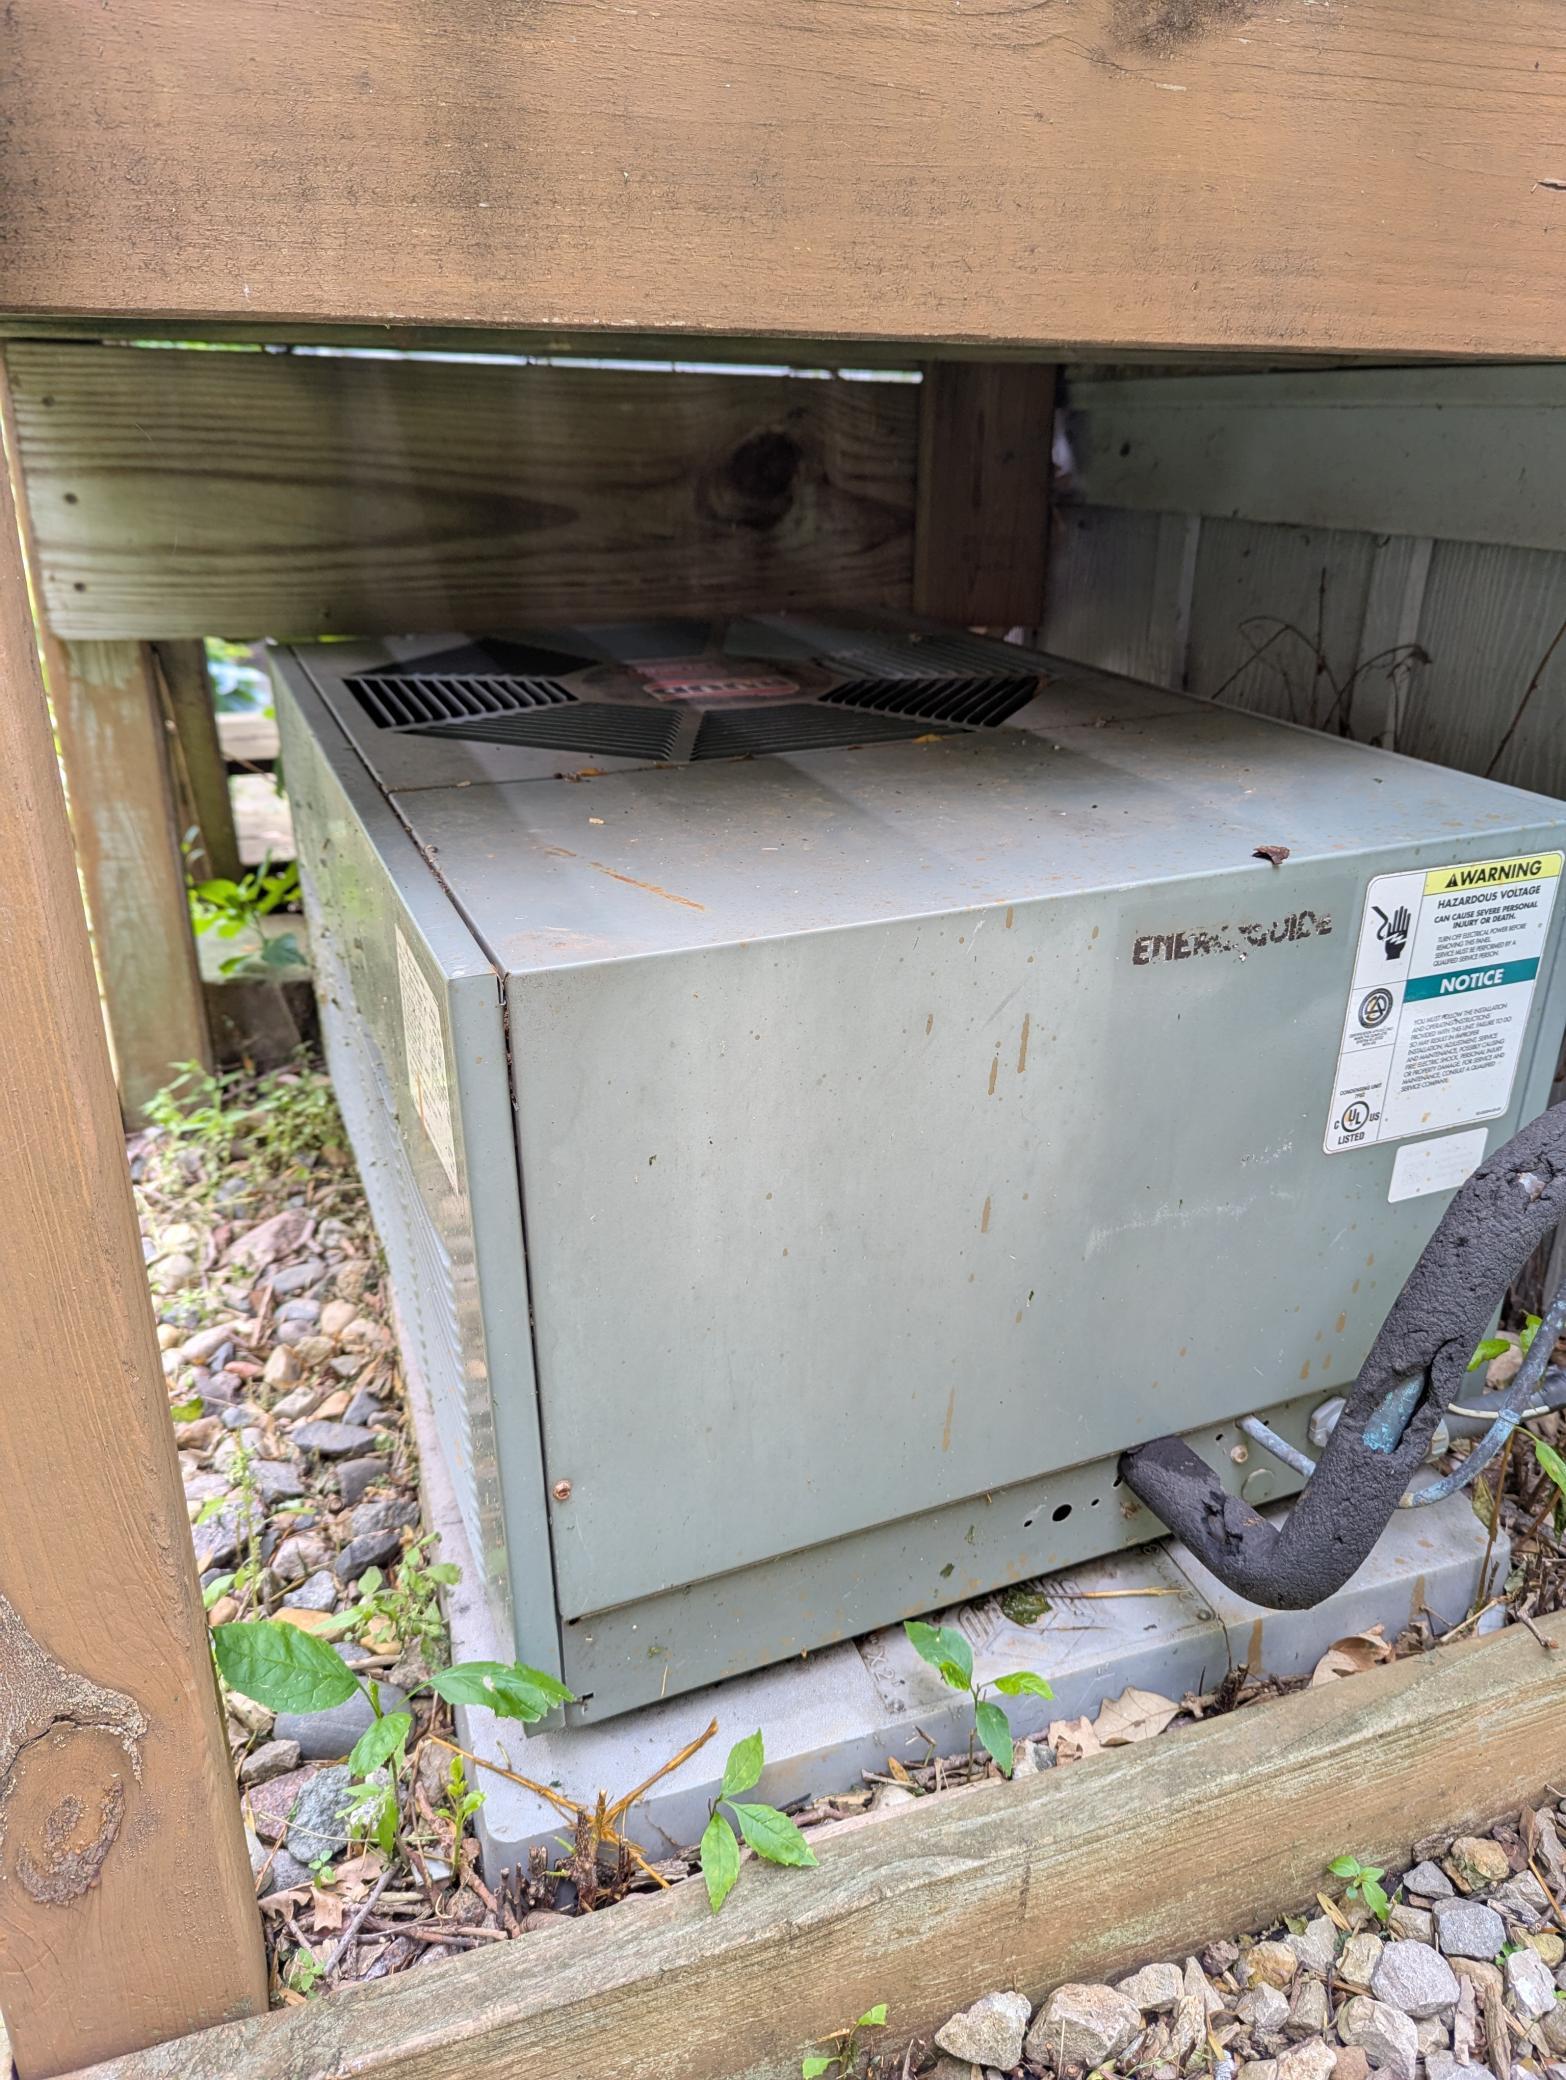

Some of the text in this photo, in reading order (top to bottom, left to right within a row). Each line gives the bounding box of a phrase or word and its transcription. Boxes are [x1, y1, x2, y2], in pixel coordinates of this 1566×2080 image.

[1459, 860, 1543, 886] WARNING
[1438, 884, 1541, 908] HAZARDOUS VOLTAGE
[1434, 900, 1538, 923] CAN CAUSE SEVERE PERSONAL
[1453, 912, 1516, 928] INJURY OR DEATH.
[1438, 922, 1526, 942] TURN OFF ELECTRICAL POWER BEFORE
[1435, 949, 1454, 958] SERVICE
[1455, 947, 1469, 955] MUST
[1476, 941, 1504, 951] PERFORMED
[1436, 940, 1464, 950] REMOVING
[1433, 956, 1458, 966] QUALIFIED
[1459, 953, 1478, 962] SERVICE
[1440, 968, 1504, 993] NOTICE
[1473, 1003, 1507, 1014] INSTALLATION
[1411, 1030, 1436, 1040] PROVIDED
[1412, 1025, 1425, 1033] AND
[1431, 1035, 1448, 1044] RESULT
[1478, 1033, 1497, 1042] SERVICE
[1407, 1055, 1418, 1063] AND
[1481, 1039, 1504, 1048] CAUSING
[1460, 1049, 1485, 1060] PERSONAL
[1486, 1046, 1503, 1054] INJURY
[1413, 1066, 1436, 1076] PROPERTY
[1473, 1055, 1492, 1064] SERVICE
[1493, 1052, 1505, 1060] AND
[1442, 1067, 1465, 1077] CONSULT
[1471, 1061, 1495, 1071] QUALIFIED
[1400, 1083, 1421, 1092] SERVICE
[1348, 1107, 1363, 1126] UL
[1369, 1111, 1380, 1122] US
[1334, 1120, 1340, 1129] C
[1338, 1131, 1365, 1145] LISTED
